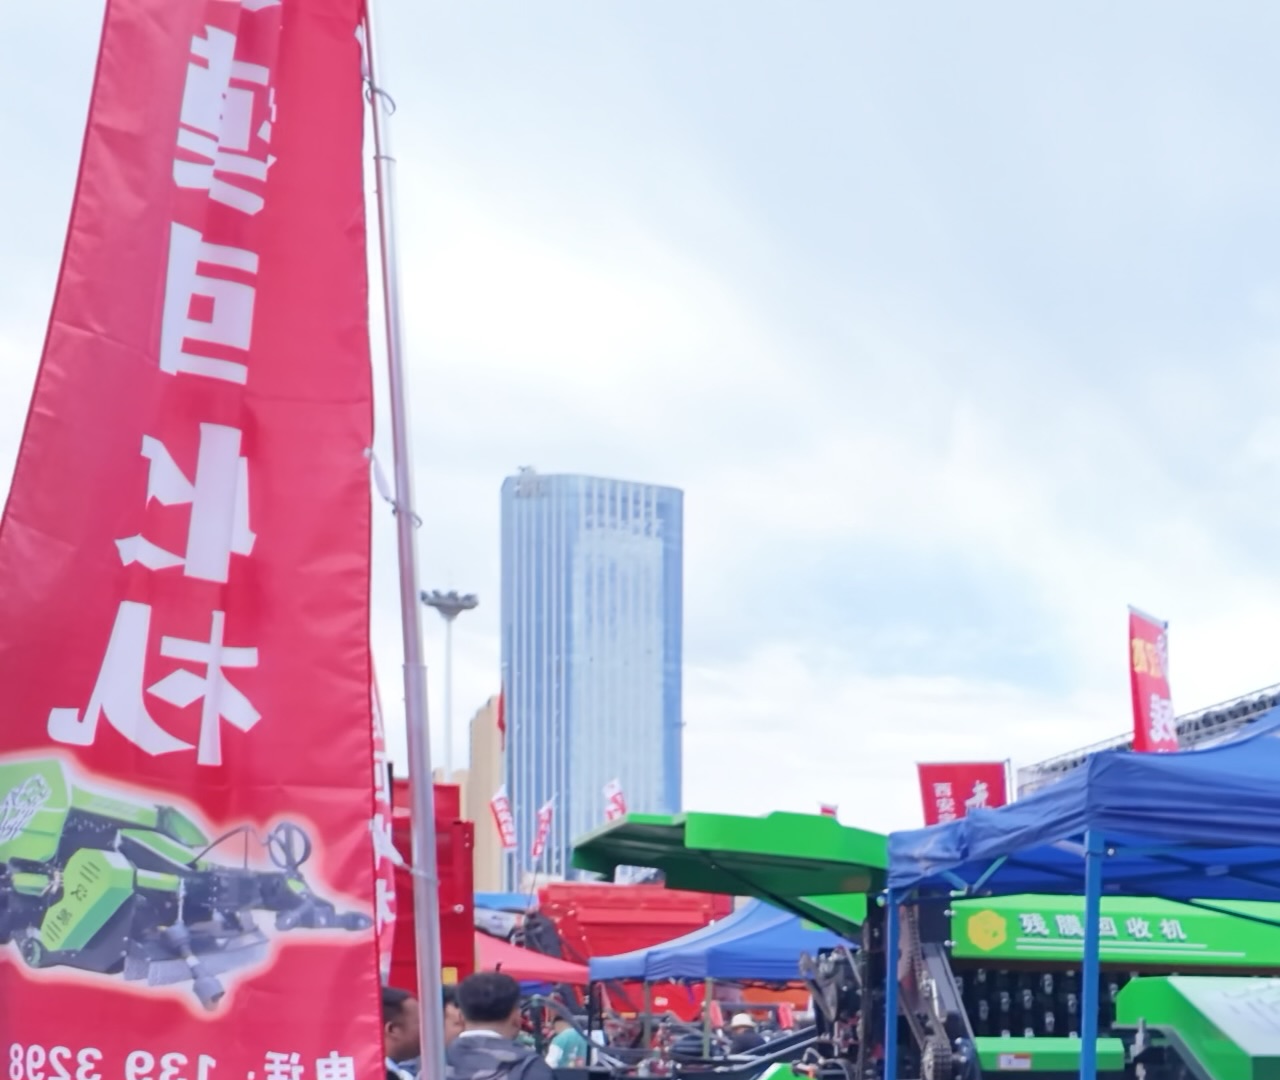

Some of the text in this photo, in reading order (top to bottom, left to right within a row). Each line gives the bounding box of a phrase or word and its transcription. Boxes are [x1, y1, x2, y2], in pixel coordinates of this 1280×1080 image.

[1018, 912, 1187, 941] 残膜回收机
